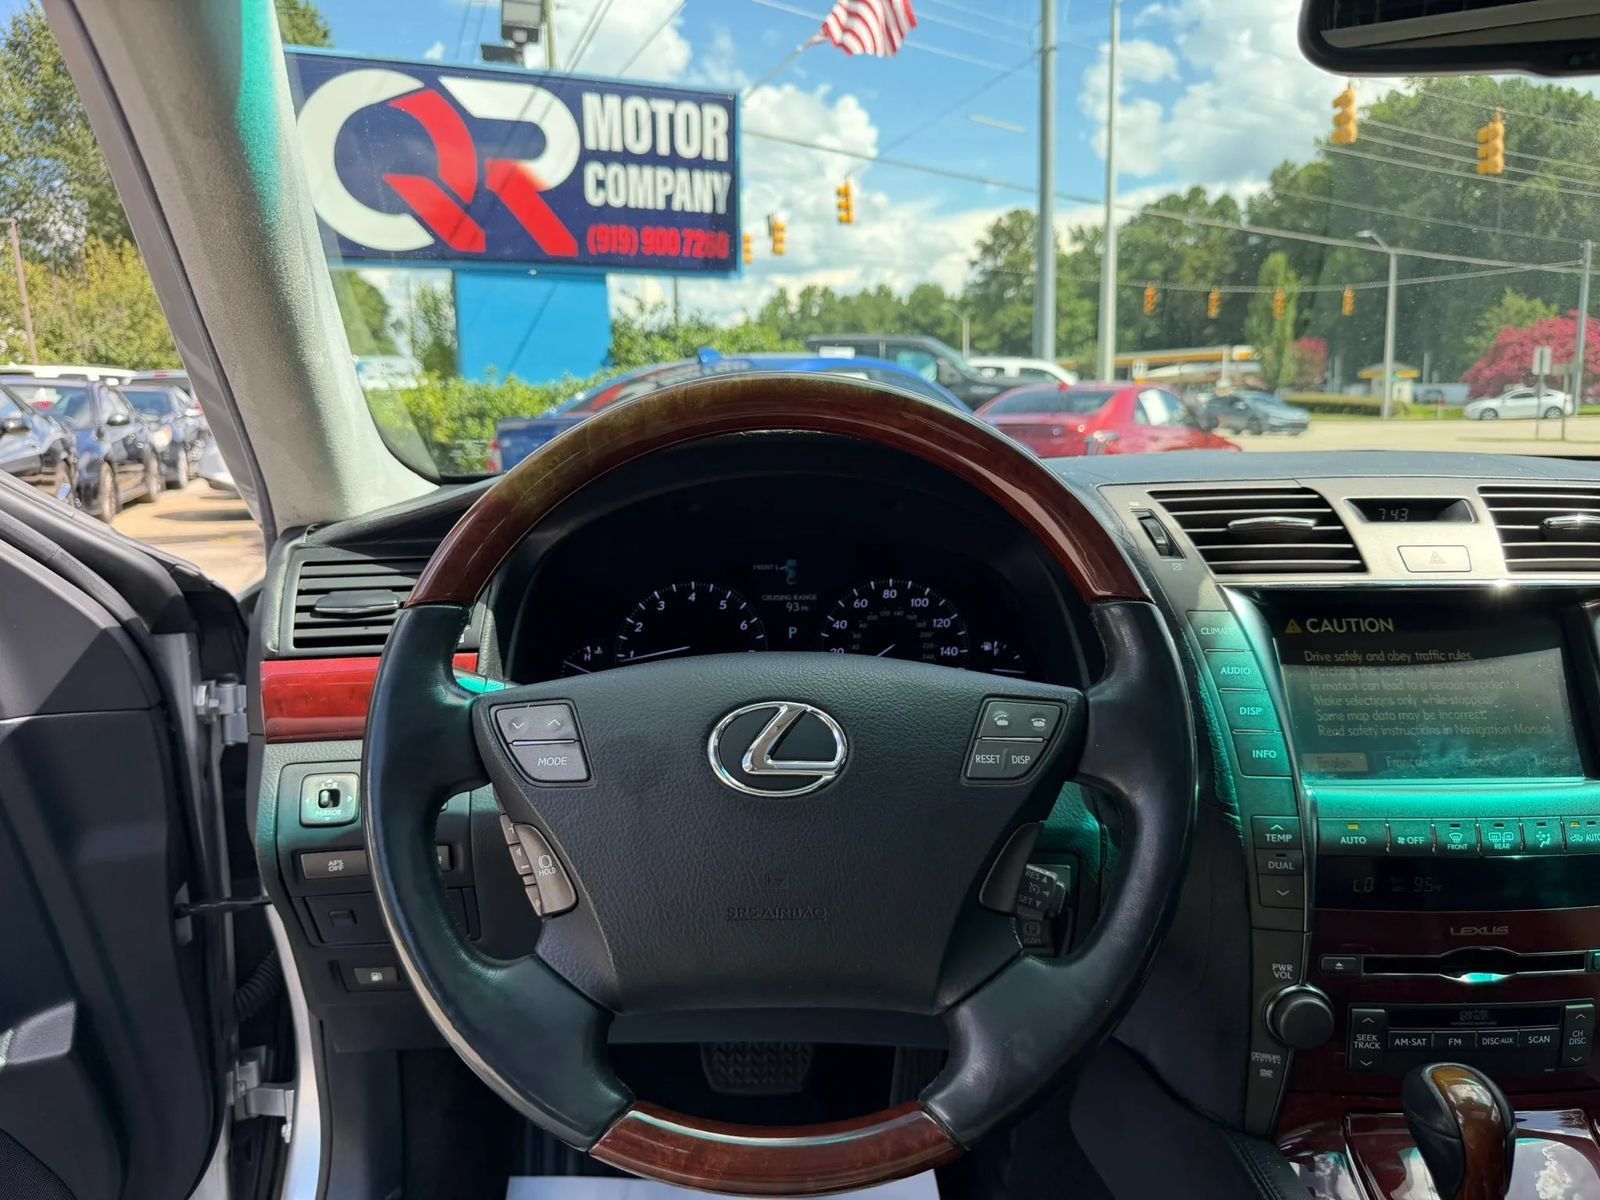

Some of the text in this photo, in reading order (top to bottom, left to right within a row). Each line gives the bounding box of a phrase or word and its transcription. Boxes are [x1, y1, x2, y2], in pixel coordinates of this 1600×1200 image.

[582, 92, 729, 162] MOTOR
[583, 161, 730, 214] COMPANY
[640, 225, 681, 257] 900
[688, 591, 697, 602] 4
[882, 588, 898, 600] 80
[656, 600, 666, 611] 3
[719, 599, 729, 610] 5
[853, 598, 869, 608] 60
[909, 597, 930, 608] 100
[634, 621, 644, 632] 2
[740, 619, 748, 631] 6
[832, 619, 848, 630] 40
[932, 617, 952, 629] 120
[1306, 617, 1395, 634] CAUTION
[788, 625, 798, 639] P
[1200, 626, 1235, 637] CLIMATE
[939, 646, 960, 658] 140
[1304, 651, 1331, 662] Drive
[1334, 650, 1362, 664] safely
[1366, 651, 1385, 662] and
[1387, 651, 1411, 664] obey
[1415, 649, 1446, 661] traffic
[1220, 666, 1251, 676] AUDIO
[1322, 681, 1359, 692] motion
[1382, 678, 1404, 691] lead
[1407, 680, 1418, 690] to
[1239, 706, 1263, 717] DISP
[1315, 709, 1345, 722] Some
[1347, 712, 1370, 723] map
[1372, 709, 1396, 721] data
[1398, 711, 1419, 723] may
[1422, 709, 1436, 721] be
[1317, 724, 1345, 737] Read
[1348, 725, 1378, 739] safety
[1380, 726, 1441, 736] instructions
[1443, 726, 1452, 736] in
[1454, 724, 1510, 738] Navigation
[1252, 748, 1277, 760] INFO
[538, 755, 568, 767] MODE
[975, 754, 1031, 766] RESET DISP
[1265, 832, 1293, 843] TEMP
[1340, 835, 1367, 846] AUTO
[1406, 836, 1425, 846] OFF
[1447, 843, 1467, 851] FRONT
[1268, 860, 1295, 871] DUAL
[538, 867, 556, 877] HOLD
[1025, 870, 1040, 880] RES
[1450, 925, 1509, 936] LEXUS
[1272, 963, 1294, 972] PWR
[1273, 971, 1293, 980] VOL
[1356, 1033, 1378, 1042] SEEK
[1572, 1029, 1584, 1038] CH
[1353, 1041, 1381, 1049] TRACK
[1448, 1037, 1462, 1047] FM
[1527, 1035, 1551, 1045] SCAN
[1568, 1037, 1587, 1046] DISC
